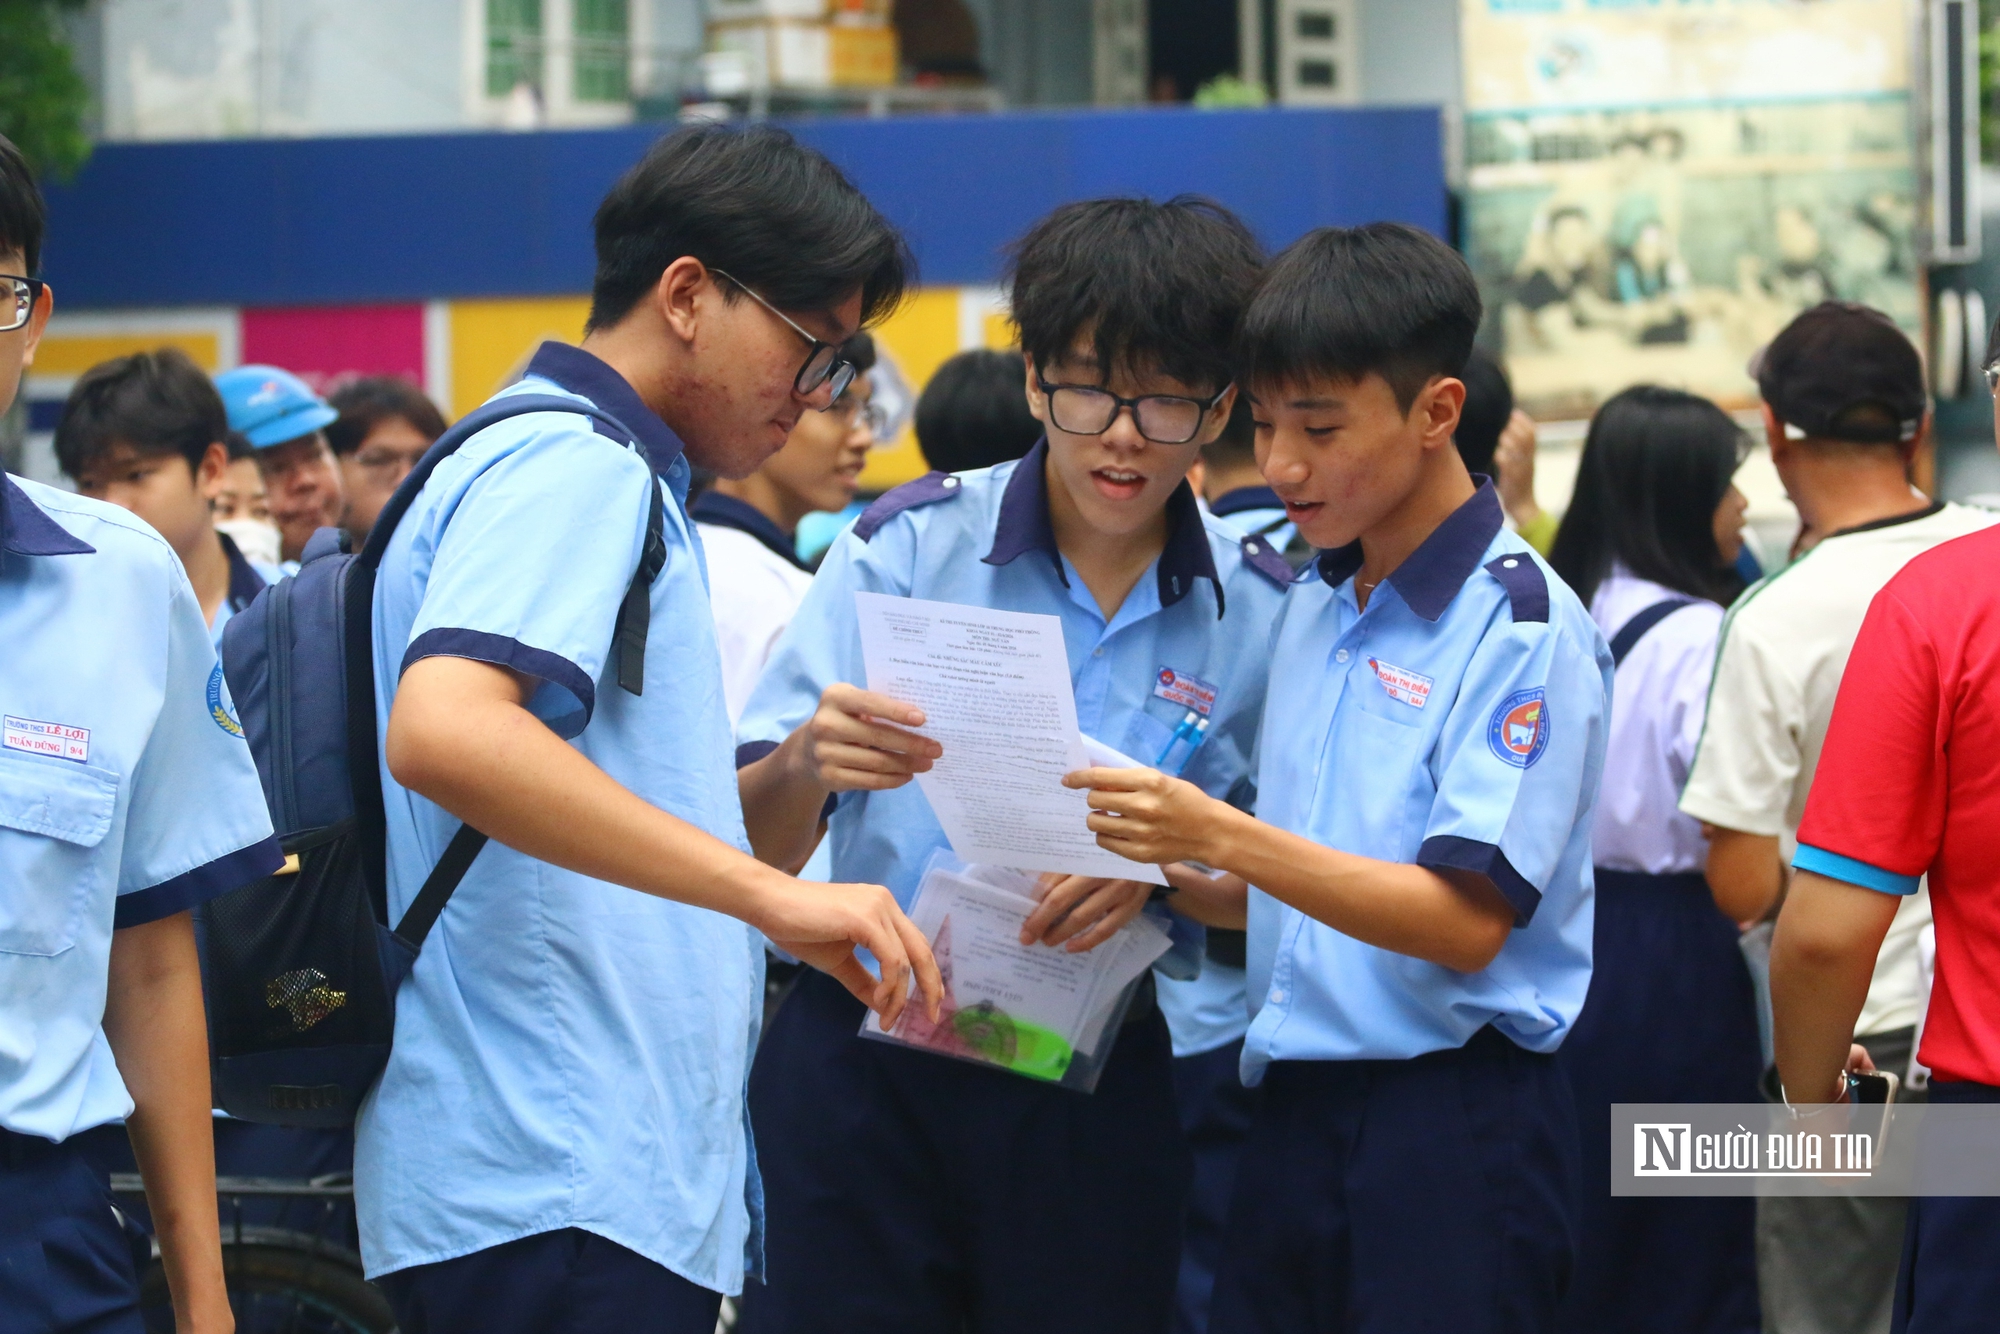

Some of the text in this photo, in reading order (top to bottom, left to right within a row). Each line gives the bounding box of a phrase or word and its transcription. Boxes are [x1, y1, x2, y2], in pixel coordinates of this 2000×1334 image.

[1378, 671, 1397, 684] ĐOÀN
[1399, 678, 1410, 689] THỊ
[1411, 682, 1429, 695] ĐIỂM
[30, 724, 45, 733] THCS
[46, 725, 61, 736] LÊ
[65, 728, 84, 741] LỢI
[9, 735, 60, 753] TUẤN DŨNG
[70, 746, 83, 756] 9/4
